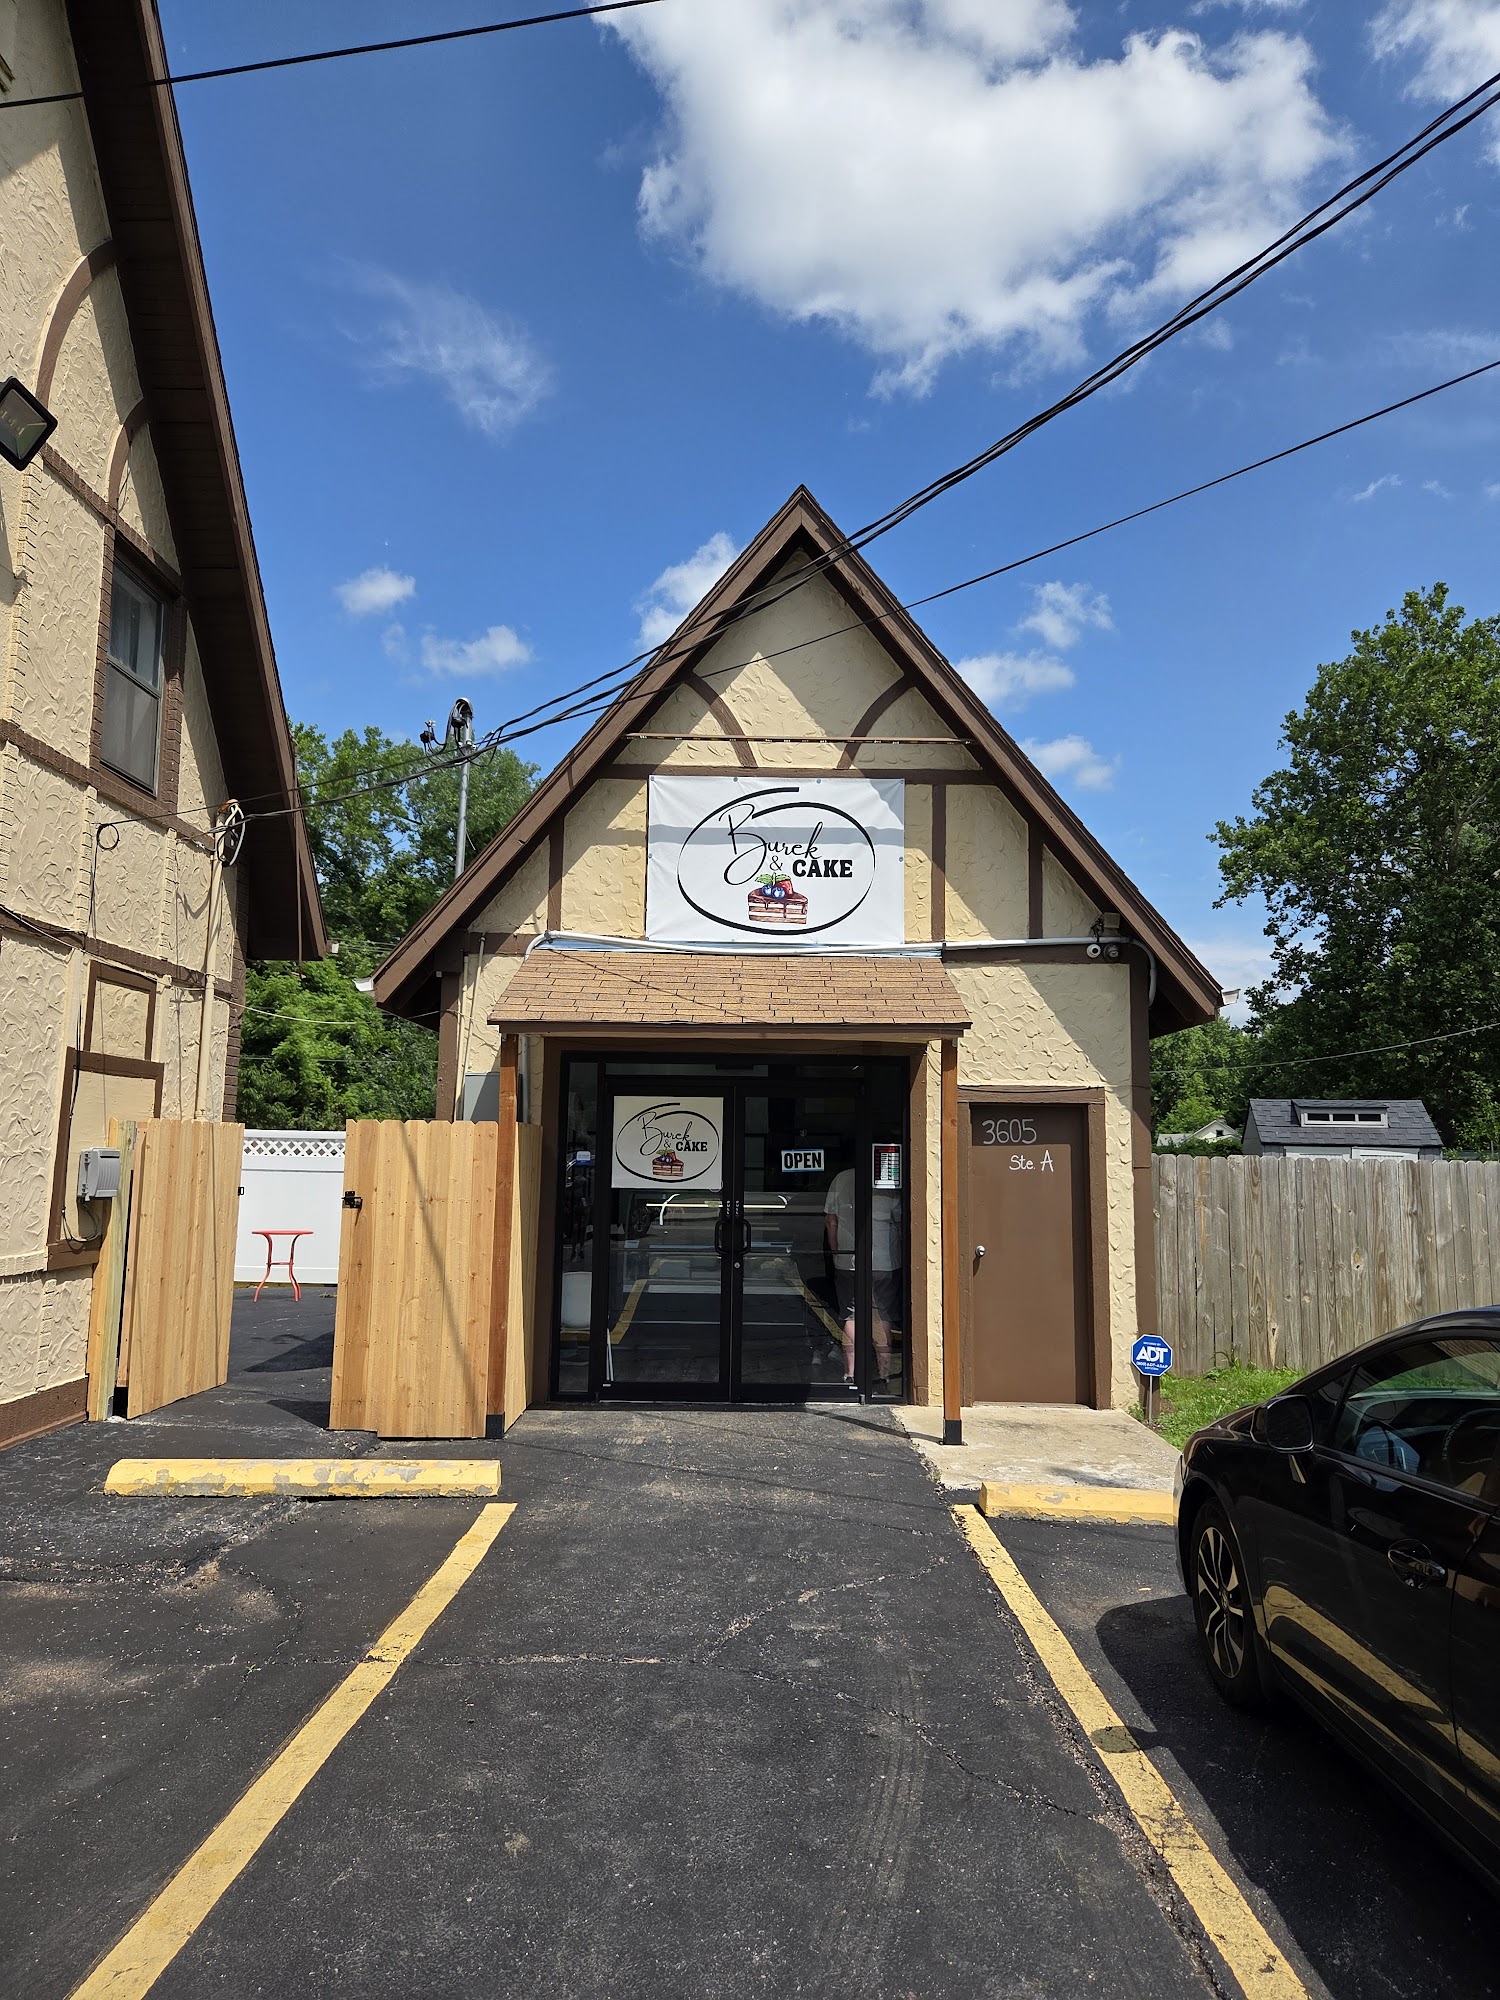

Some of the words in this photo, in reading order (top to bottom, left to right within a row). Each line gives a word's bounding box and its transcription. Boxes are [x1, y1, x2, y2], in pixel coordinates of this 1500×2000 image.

[718, 803, 824, 886] Burek
[769, 854, 784, 872] &
[792, 859, 853, 878] CAKE
[637, 1111, 693, 1156] Burek
[981, 1118, 1037, 1145] 3605
[663, 1139, 672, 1149] &
[675, 1141, 708, 1152] CAKE
[783, 1151, 822, 1170] OPEN
[1008, 1154, 1036, 1171] Ste.
[1040, 1149, 1054, 1173] A
[1136, 1346, 1168, 1363] ADT
